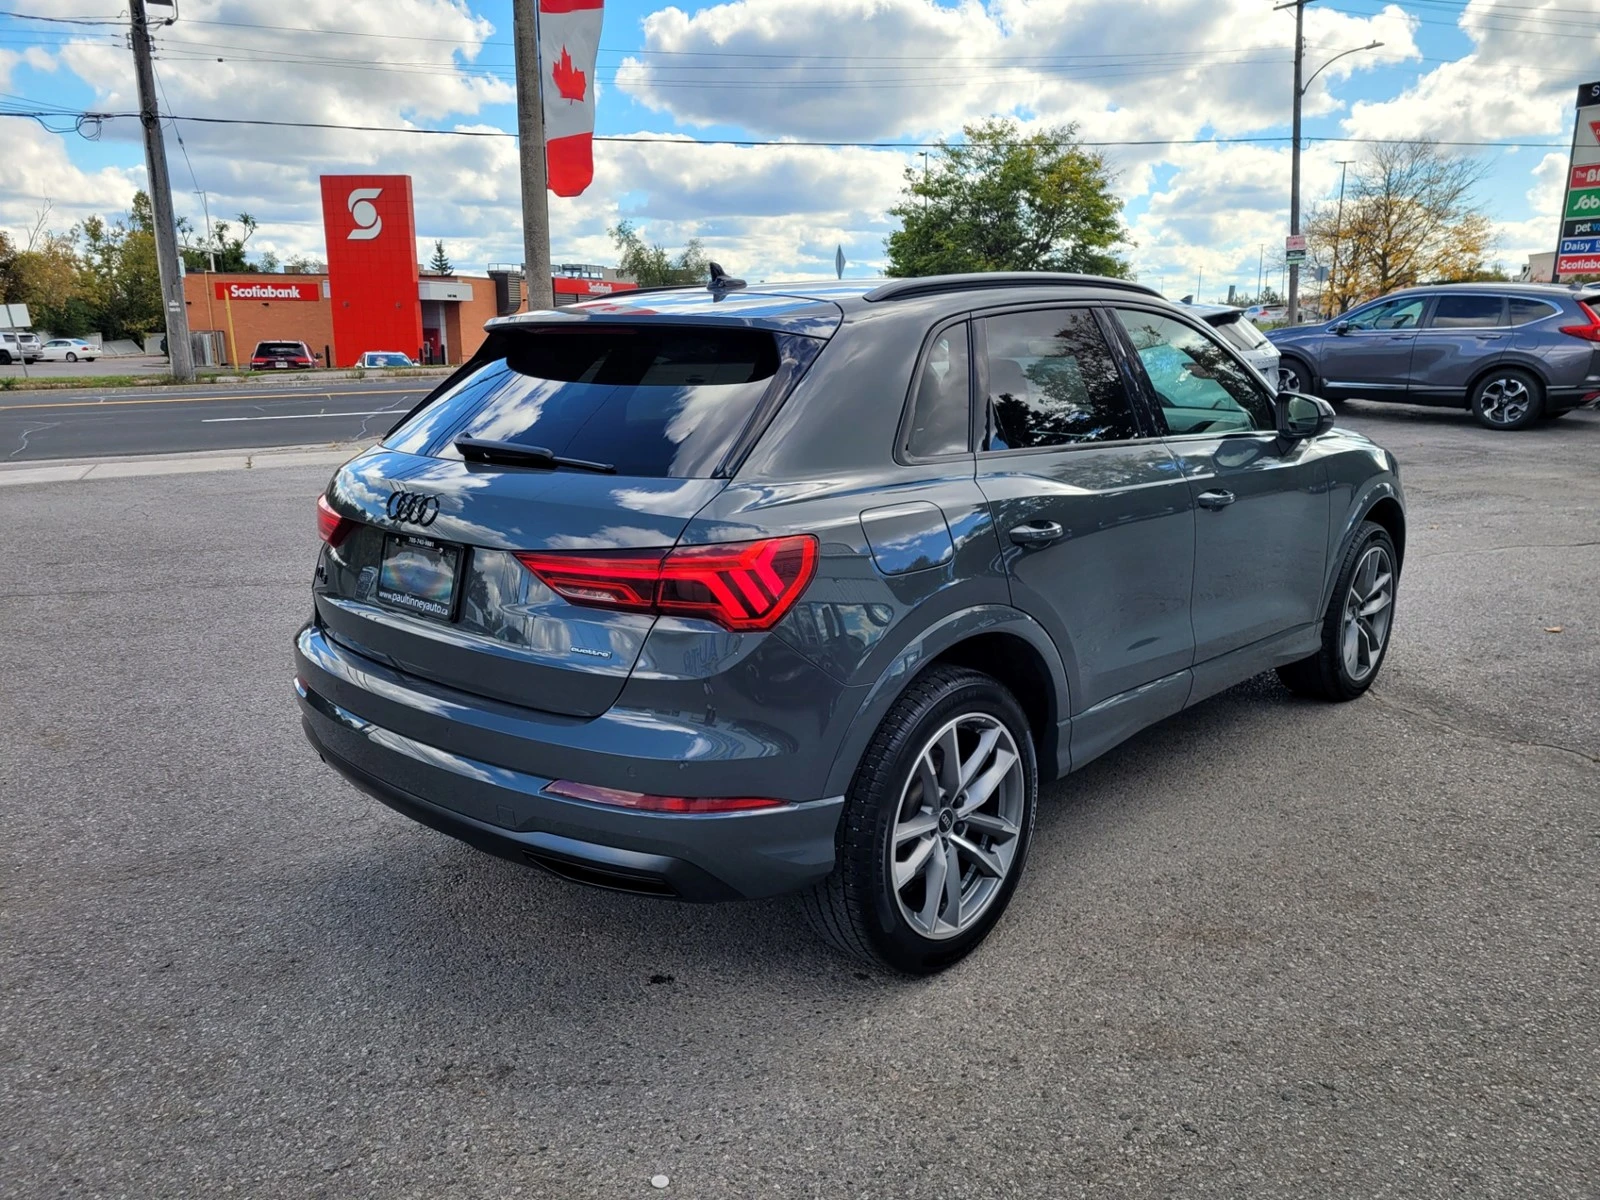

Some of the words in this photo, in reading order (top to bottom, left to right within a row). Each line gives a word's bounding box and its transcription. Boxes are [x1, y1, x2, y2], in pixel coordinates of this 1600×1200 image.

[1575, 170, 1587, 179] The
[1573, 194, 1600, 210] Sob
[1574, 222, 1591, 235] pet
[1564, 241, 1591, 252] Daisy
[230, 284, 301, 298] Scotiabank
[379, 591, 449, 616] www.paultinneyauto.ca
[571, 647, 610, 658] quattro
